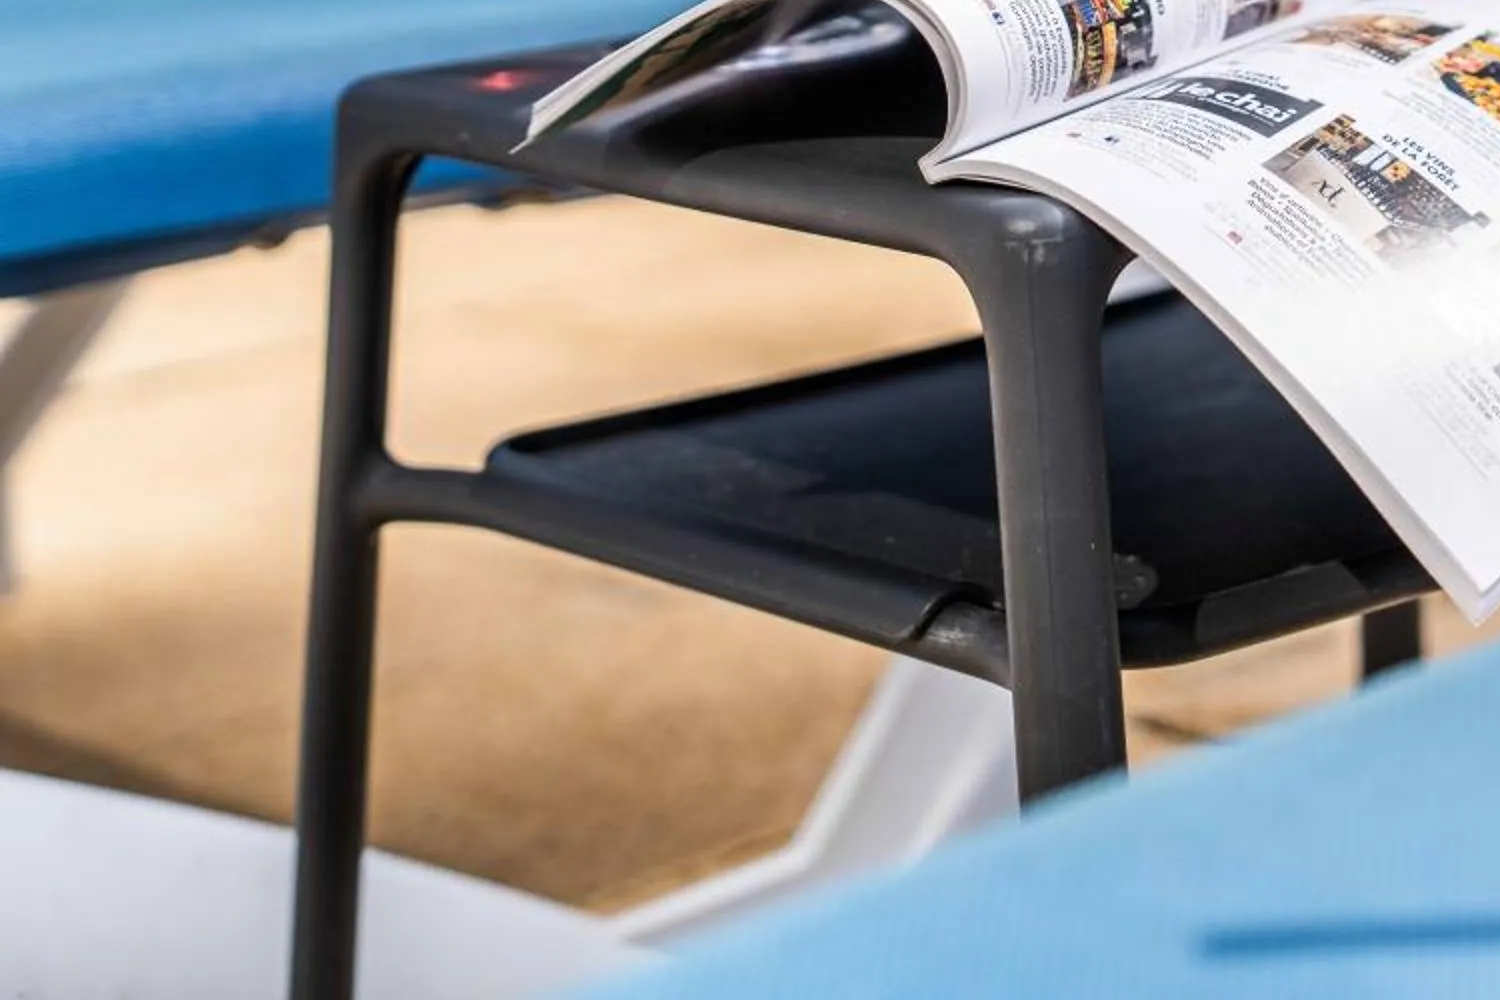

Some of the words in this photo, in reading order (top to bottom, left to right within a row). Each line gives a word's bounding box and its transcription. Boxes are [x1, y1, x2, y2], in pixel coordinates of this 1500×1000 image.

[1381, 133, 1401, 149] DE
[1401, 146, 1420, 161] LA
[1402, 135, 1425, 155] LES
[1424, 151, 1456, 177] VINS
